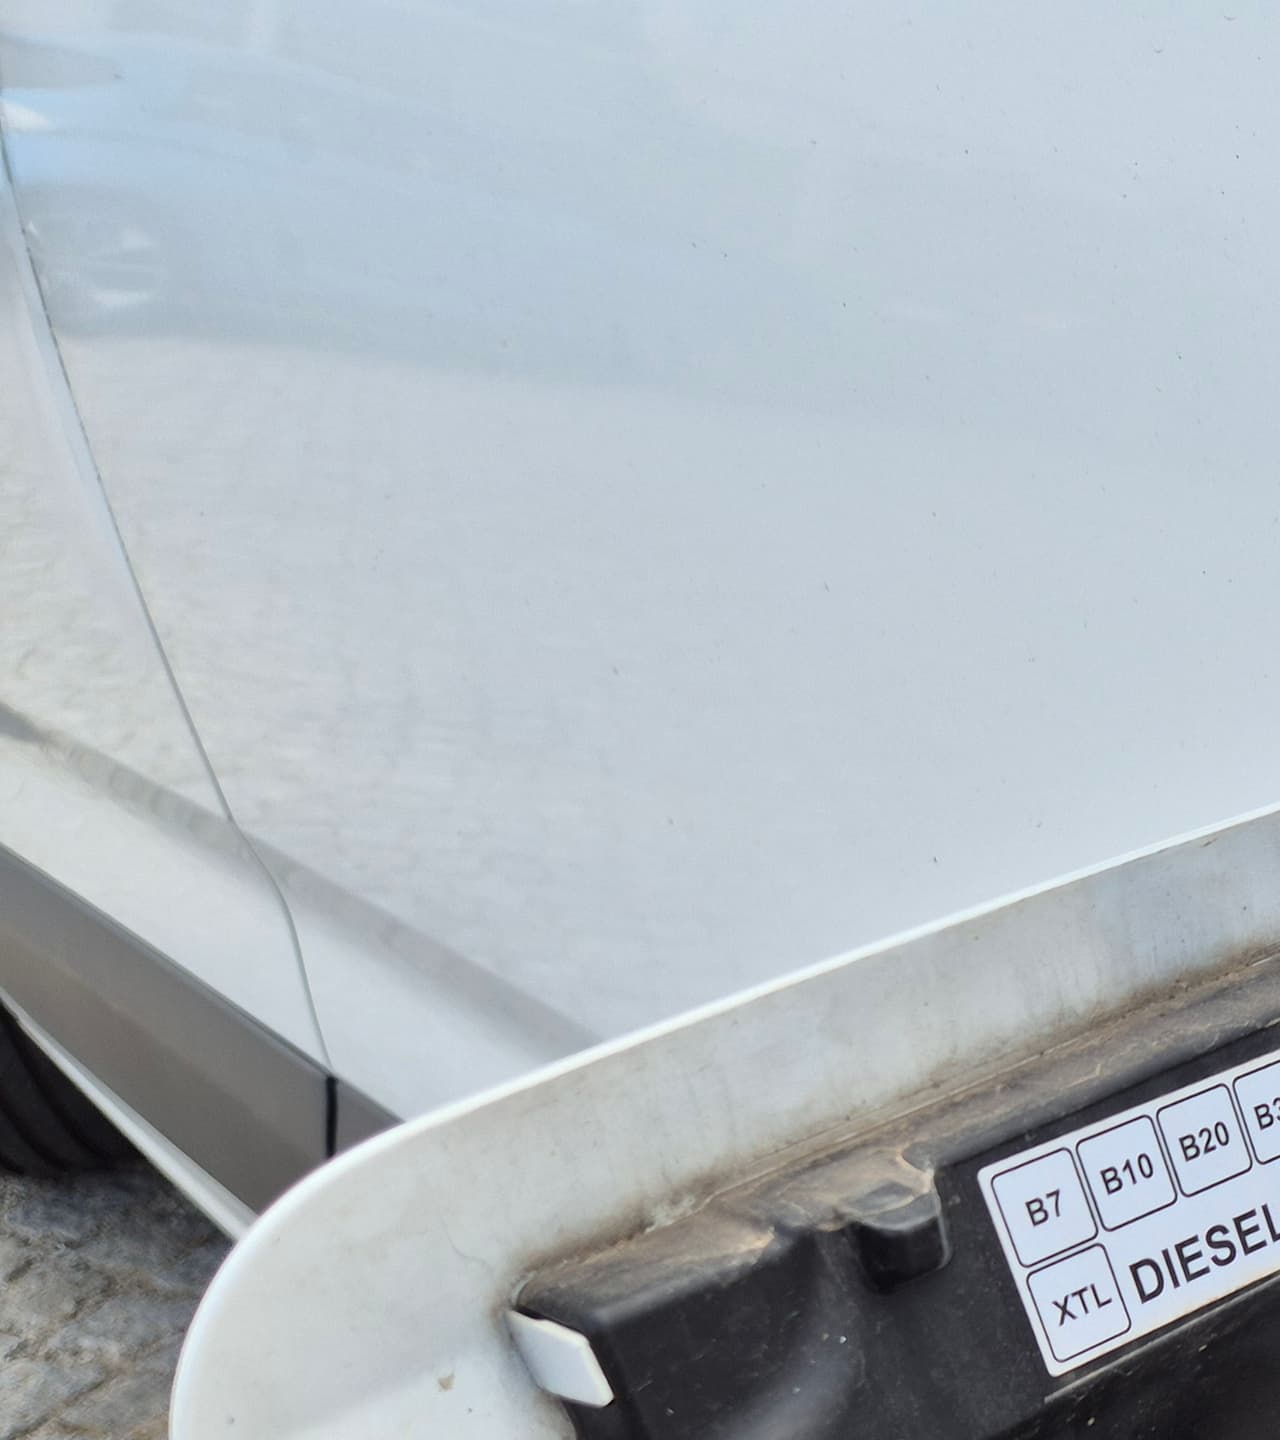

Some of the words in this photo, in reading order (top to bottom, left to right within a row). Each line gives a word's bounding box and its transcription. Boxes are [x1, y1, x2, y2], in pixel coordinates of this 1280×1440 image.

[1025, 1189, 1061, 1227] B7
[1100, 1153, 1154, 1195] B10
[1178, 1121, 1230, 1162] B20
[1052, 1283, 1112, 1326] XTL
